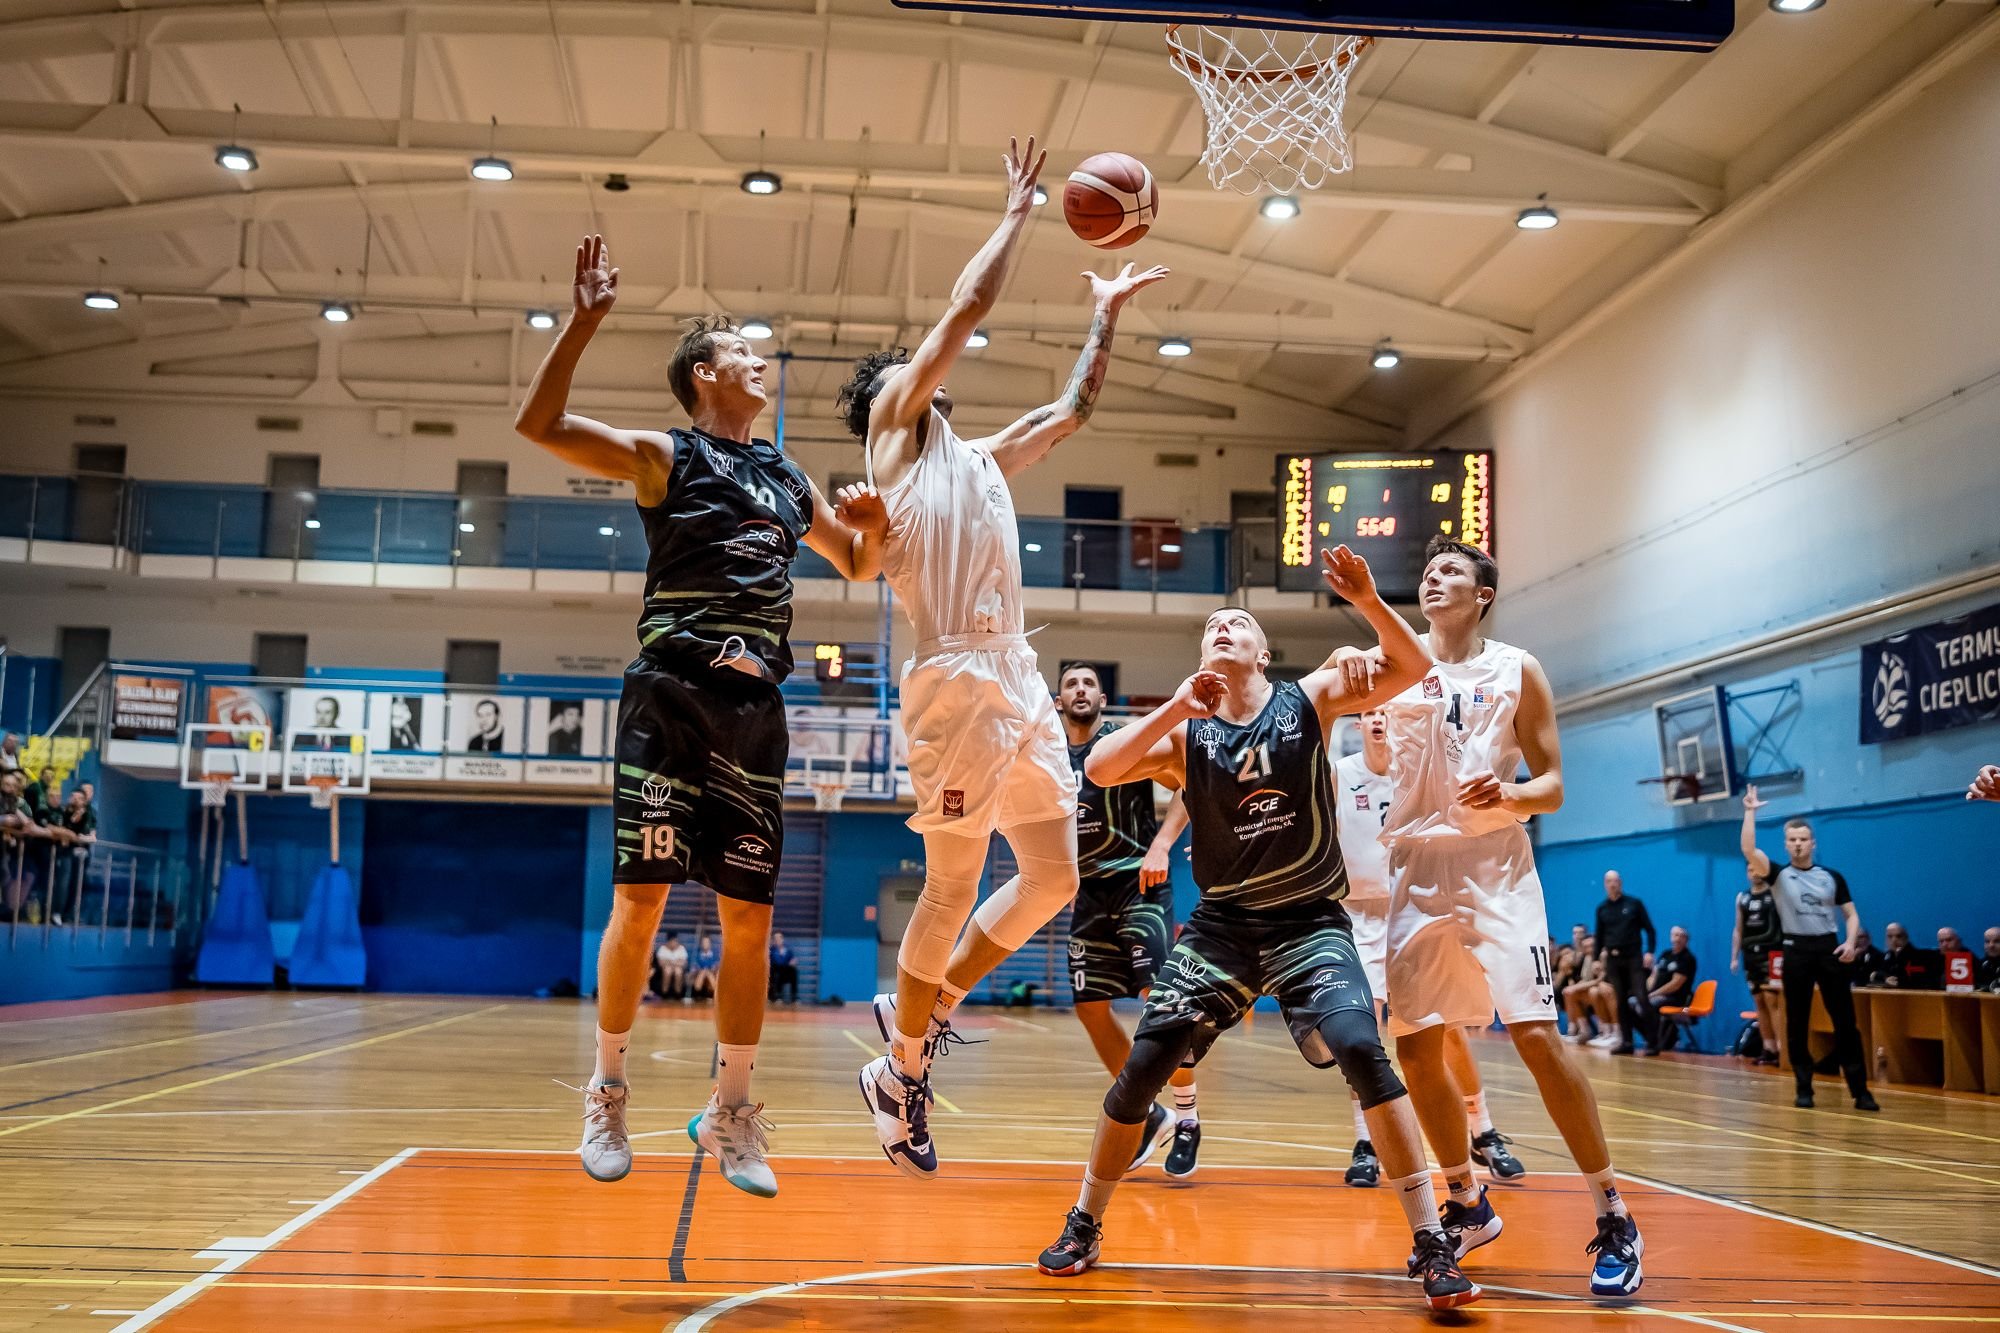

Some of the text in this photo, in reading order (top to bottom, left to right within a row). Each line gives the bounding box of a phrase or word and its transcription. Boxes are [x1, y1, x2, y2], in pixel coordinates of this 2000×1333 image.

[1431, 483, 1451, 503] 19
[829, 657, 843, 678] 6
[1920, 667, 2000, 713] CIEPLIC
[1235, 741, 1272, 782] 21
[642, 810, 670, 818] PZKOSZ
[1249, 797, 1279, 815] PGE
[640, 825, 674, 861] 19
[738, 841, 765, 855] PGE
[1530, 945, 1551, 986] 11
[1950, 958, 1968, 980] 5
